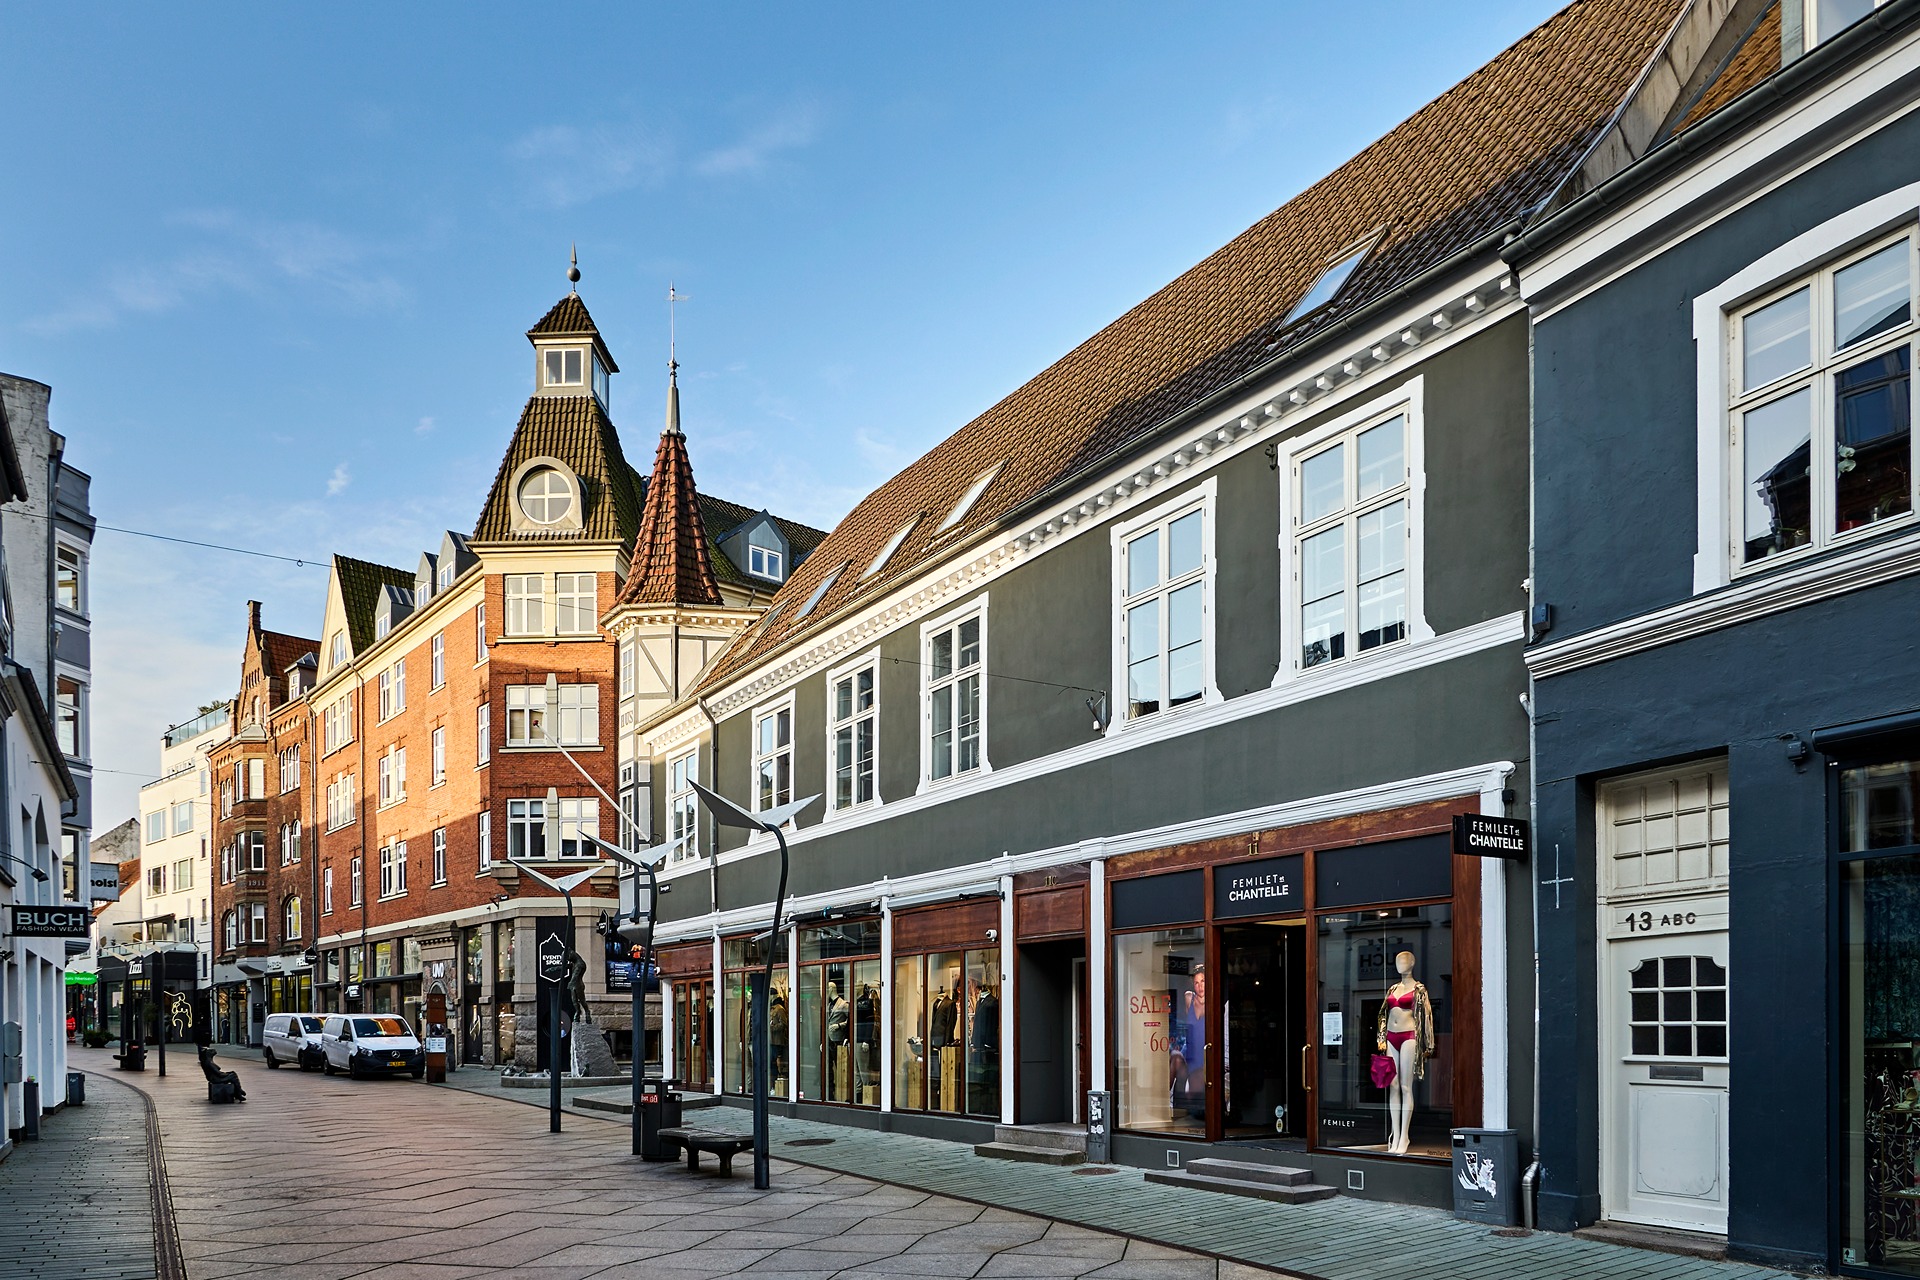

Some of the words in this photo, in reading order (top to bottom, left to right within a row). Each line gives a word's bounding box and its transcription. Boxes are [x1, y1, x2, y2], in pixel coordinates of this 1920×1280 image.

[620, 710, 634, 728] HUS
[1472, 821, 1514, 835] FEMILET
[1247, 842, 1259, 856] 11
[1469, 834, 1524, 850] CHANTELLE
[1232, 874, 1278, 889] FEMILET
[1229, 884, 1289, 901] CHANTELLE
[16, 912, 84, 926] BUCH
[1625, 911, 1652, 932] 13
[1660, 912, 1696, 926] ABC
[1130, 994, 1171, 1014] SALE
[1322, 1118, 1356, 1128] FEMILET
